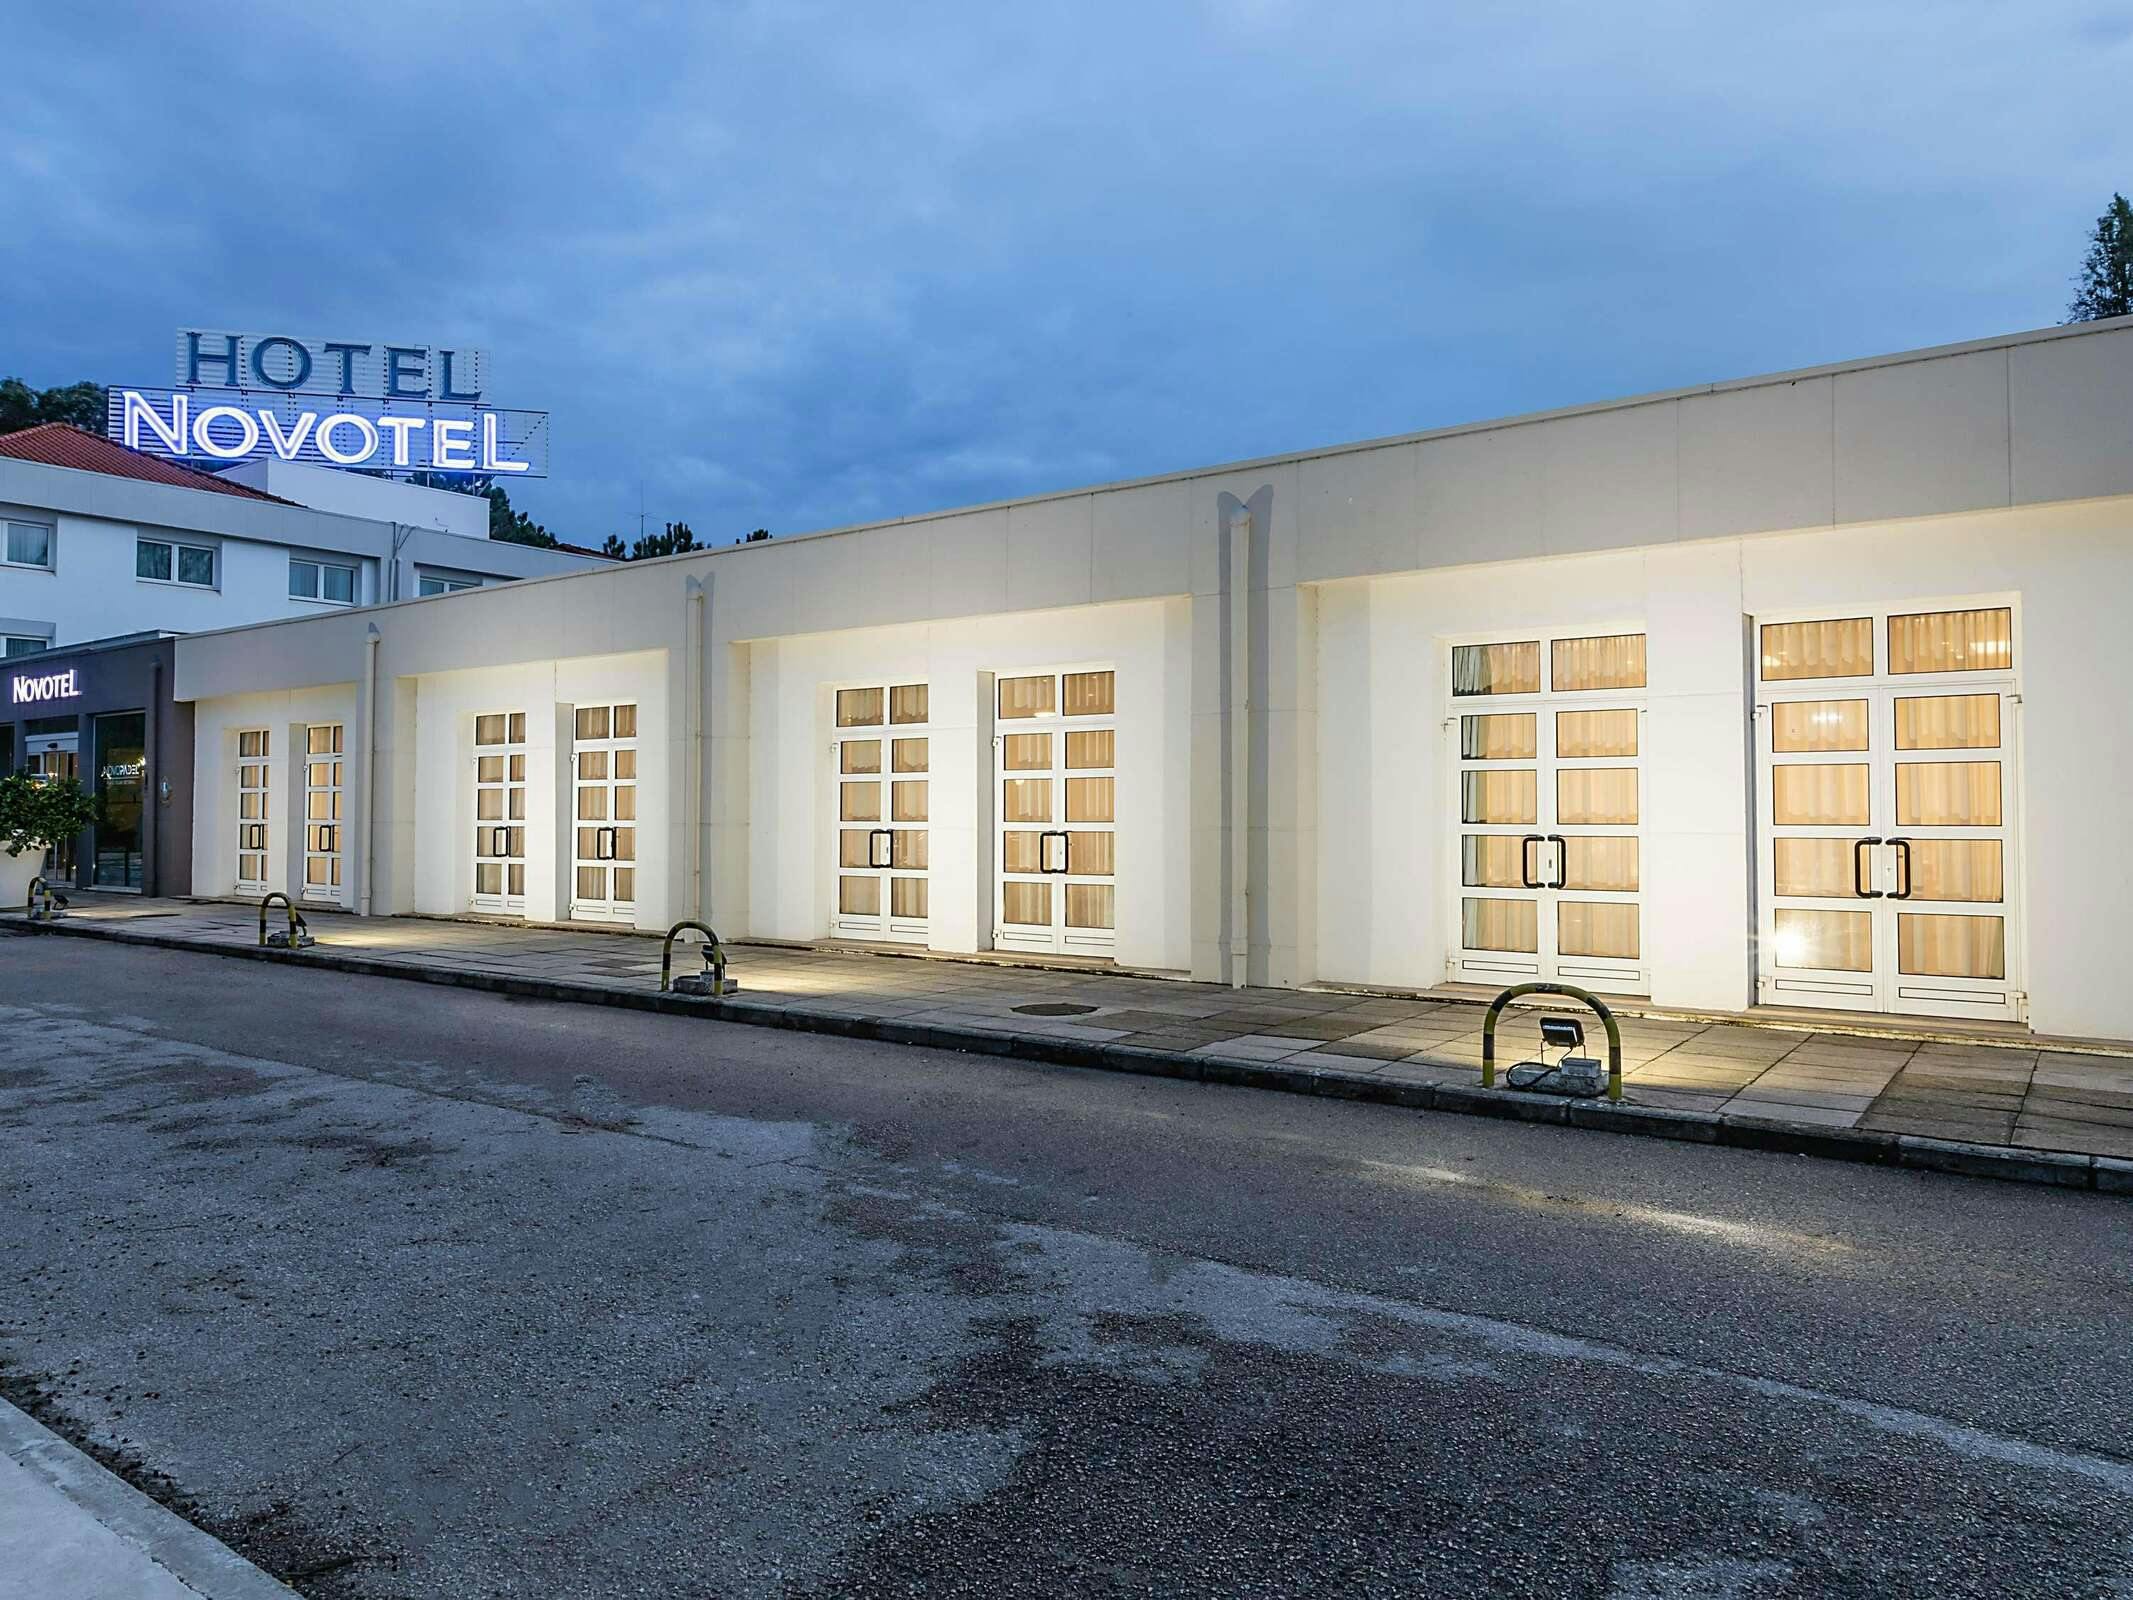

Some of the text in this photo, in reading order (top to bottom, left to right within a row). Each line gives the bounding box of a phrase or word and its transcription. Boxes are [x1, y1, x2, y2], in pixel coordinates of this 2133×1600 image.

[185, 331, 482, 401] HOTEL
[122, 391, 530, 472] NOVOTEL
[13, 669, 79, 703] NOVOTEL
